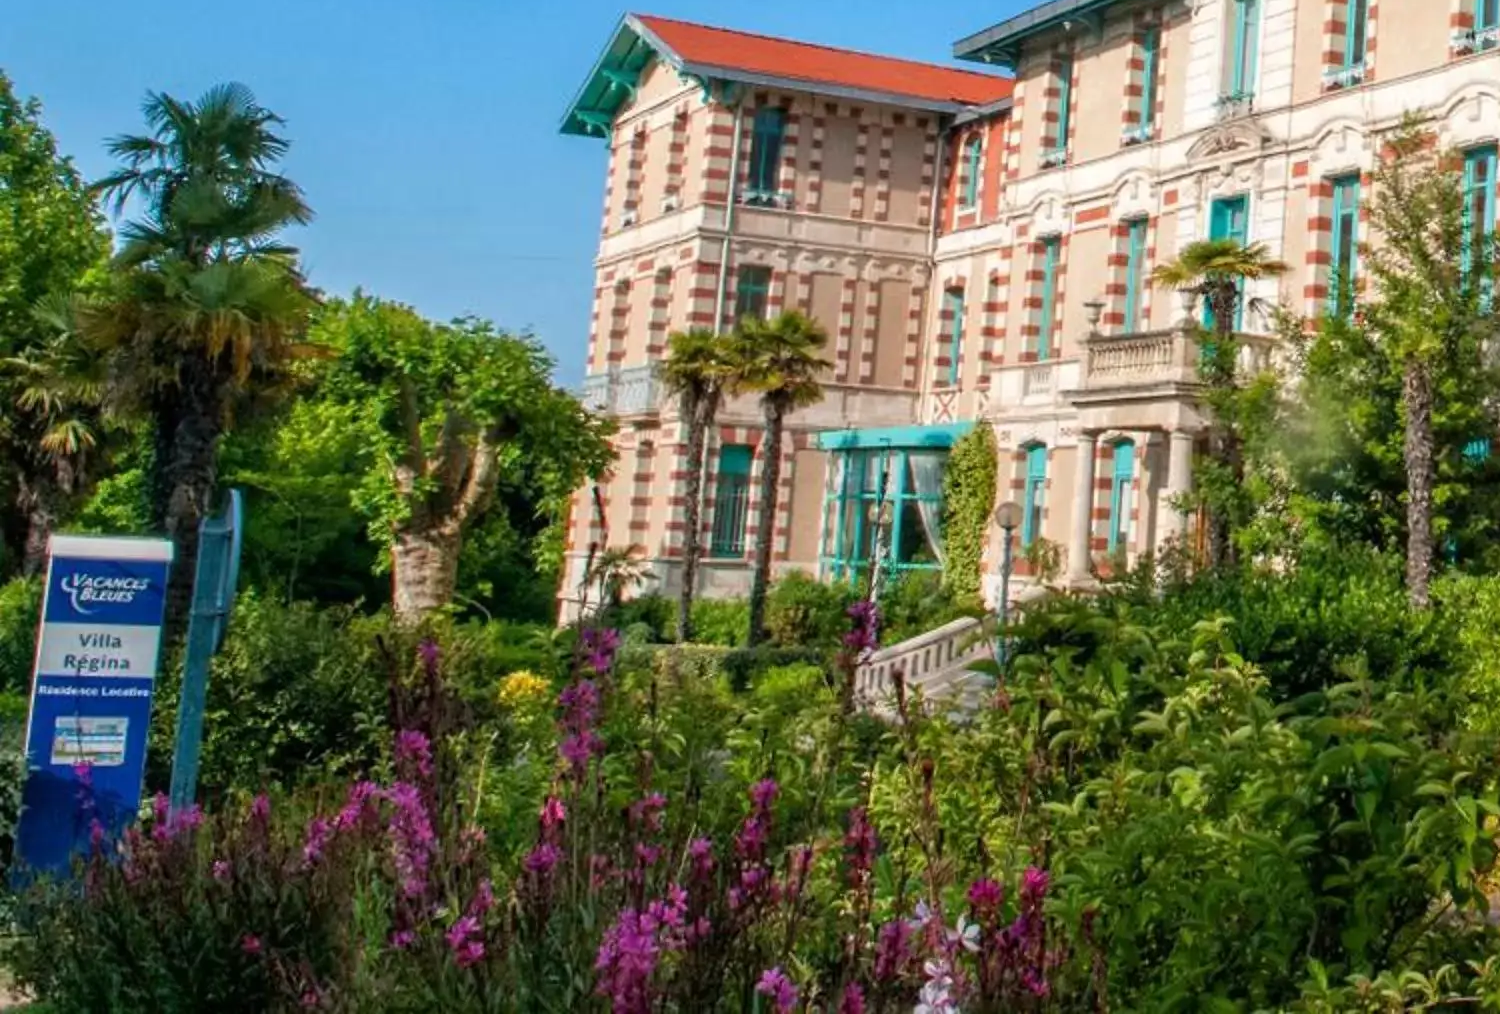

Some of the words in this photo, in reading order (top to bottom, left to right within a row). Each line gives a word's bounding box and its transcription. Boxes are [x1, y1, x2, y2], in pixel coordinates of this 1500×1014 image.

[79, 587, 136, 602] BLEUES
[78, 633, 123, 649] Villa
[63, 653, 130, 673] Régina
